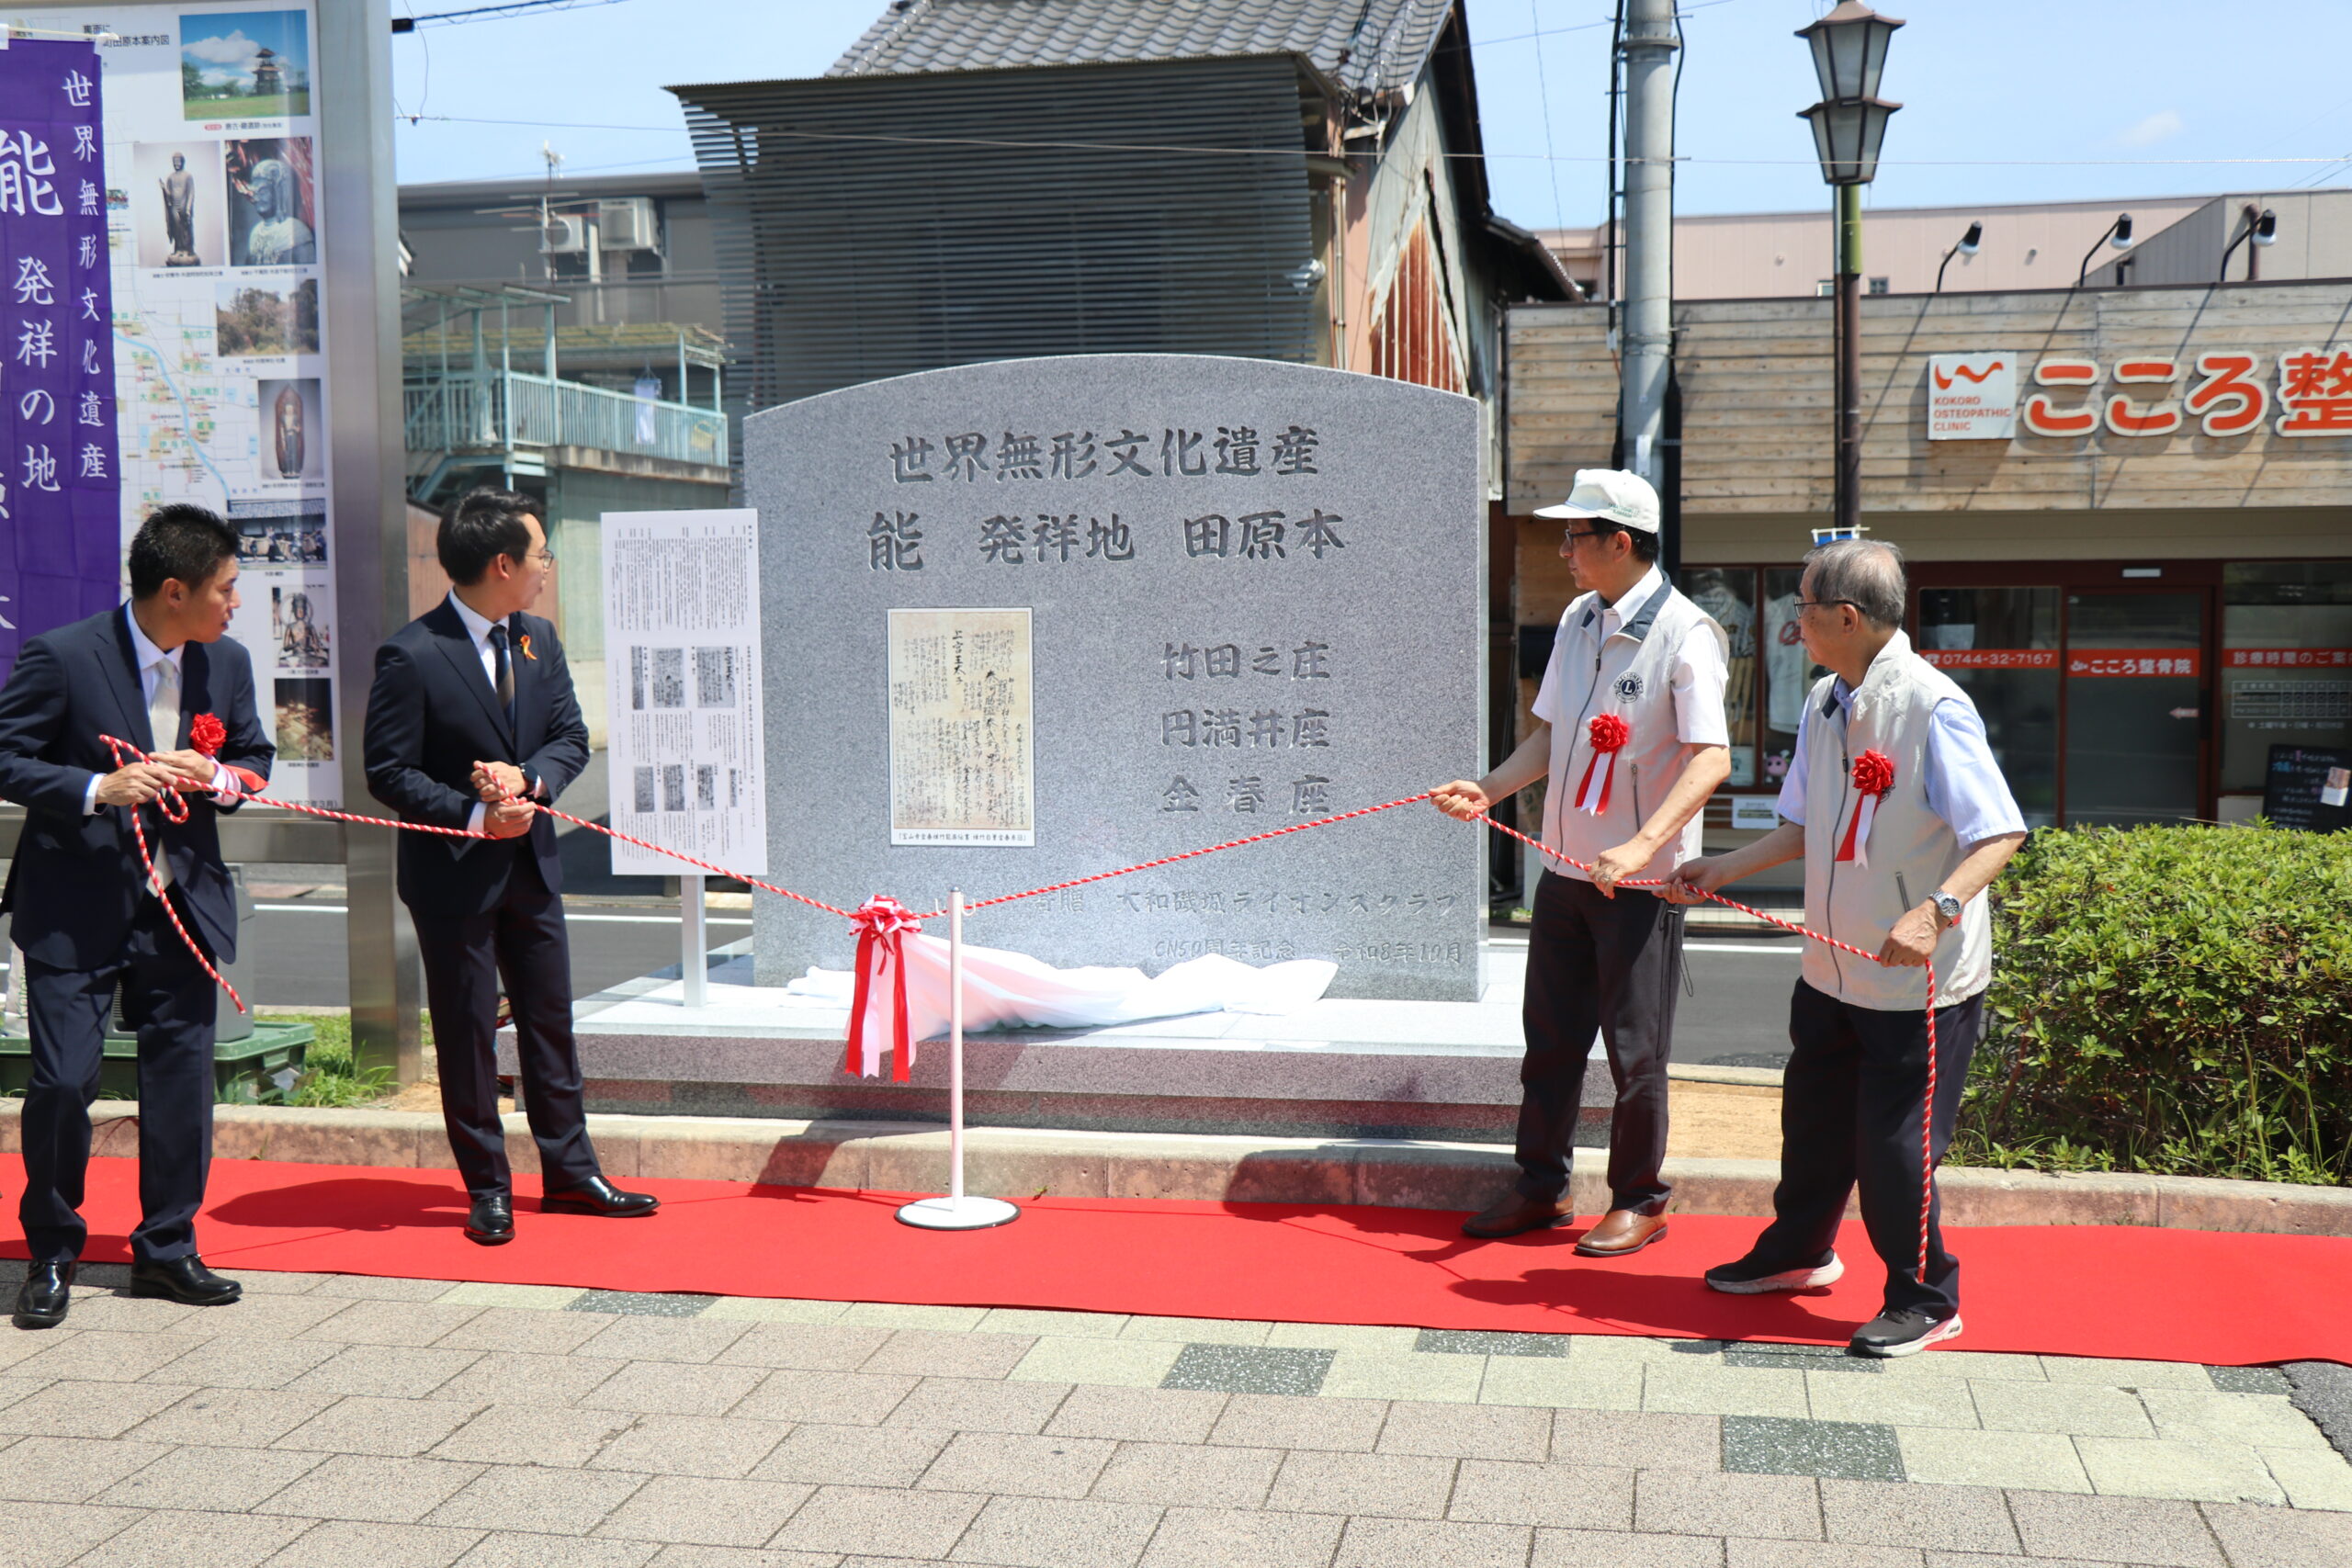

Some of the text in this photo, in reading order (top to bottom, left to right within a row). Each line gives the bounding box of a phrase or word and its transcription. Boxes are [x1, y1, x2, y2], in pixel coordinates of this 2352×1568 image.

[62, 70, 108, 479] 世界無形文化遺産
[13, 255, 62, 492] 発祥の地
[2026, 353, 2352, 434] こころ整
[1934, 397, 1981, 405] KOKORO
[1934, 409, 2011, 419] OSTEOPATHIC
[1933, 423, 1971, 431] CLINIC
[888, 424, 1321, 485] 世界無形文化遺産
[866, 508, 1347, 572] 能 発祥地 田原本
[1161, 640, 1332, 682] 竹田之庄
[2090, 659, 2192, 674] こころ整骨院
[1160, 708, 1332, 750] 円満井座
[1116, 886, 1464, 917] 大和磯城ライオンズクラブ
